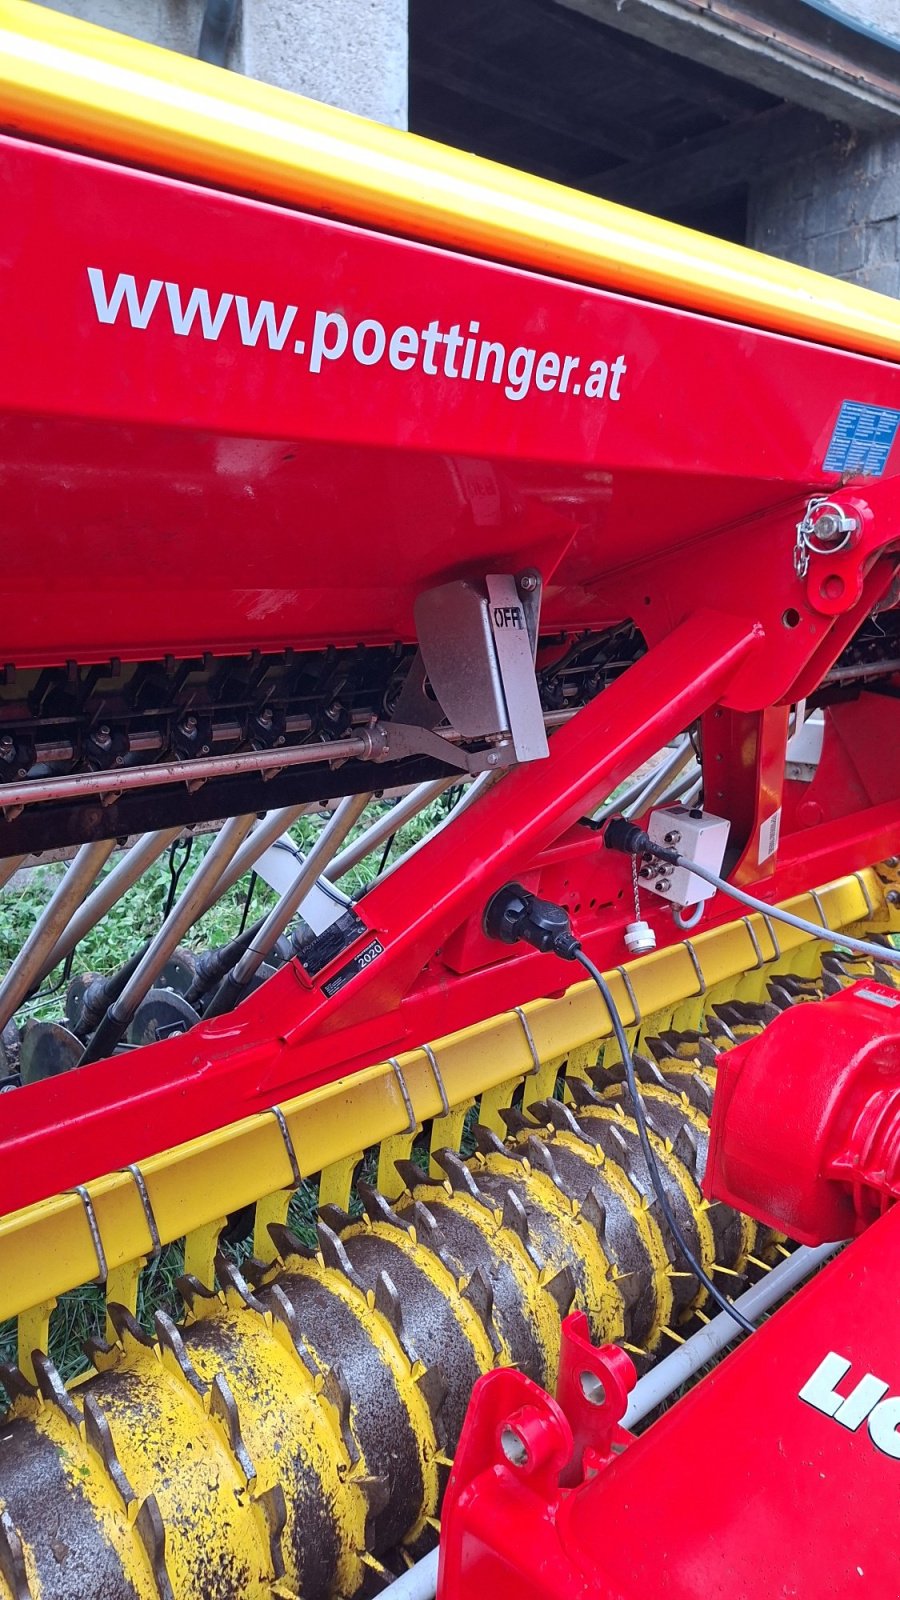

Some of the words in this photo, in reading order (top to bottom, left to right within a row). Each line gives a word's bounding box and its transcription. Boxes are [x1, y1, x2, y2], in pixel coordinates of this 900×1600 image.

[87, 267, 627, 400] www.poettinger.at
[494, 607, 521, 628] OFF
[358, 944, 382, 967] 2020
